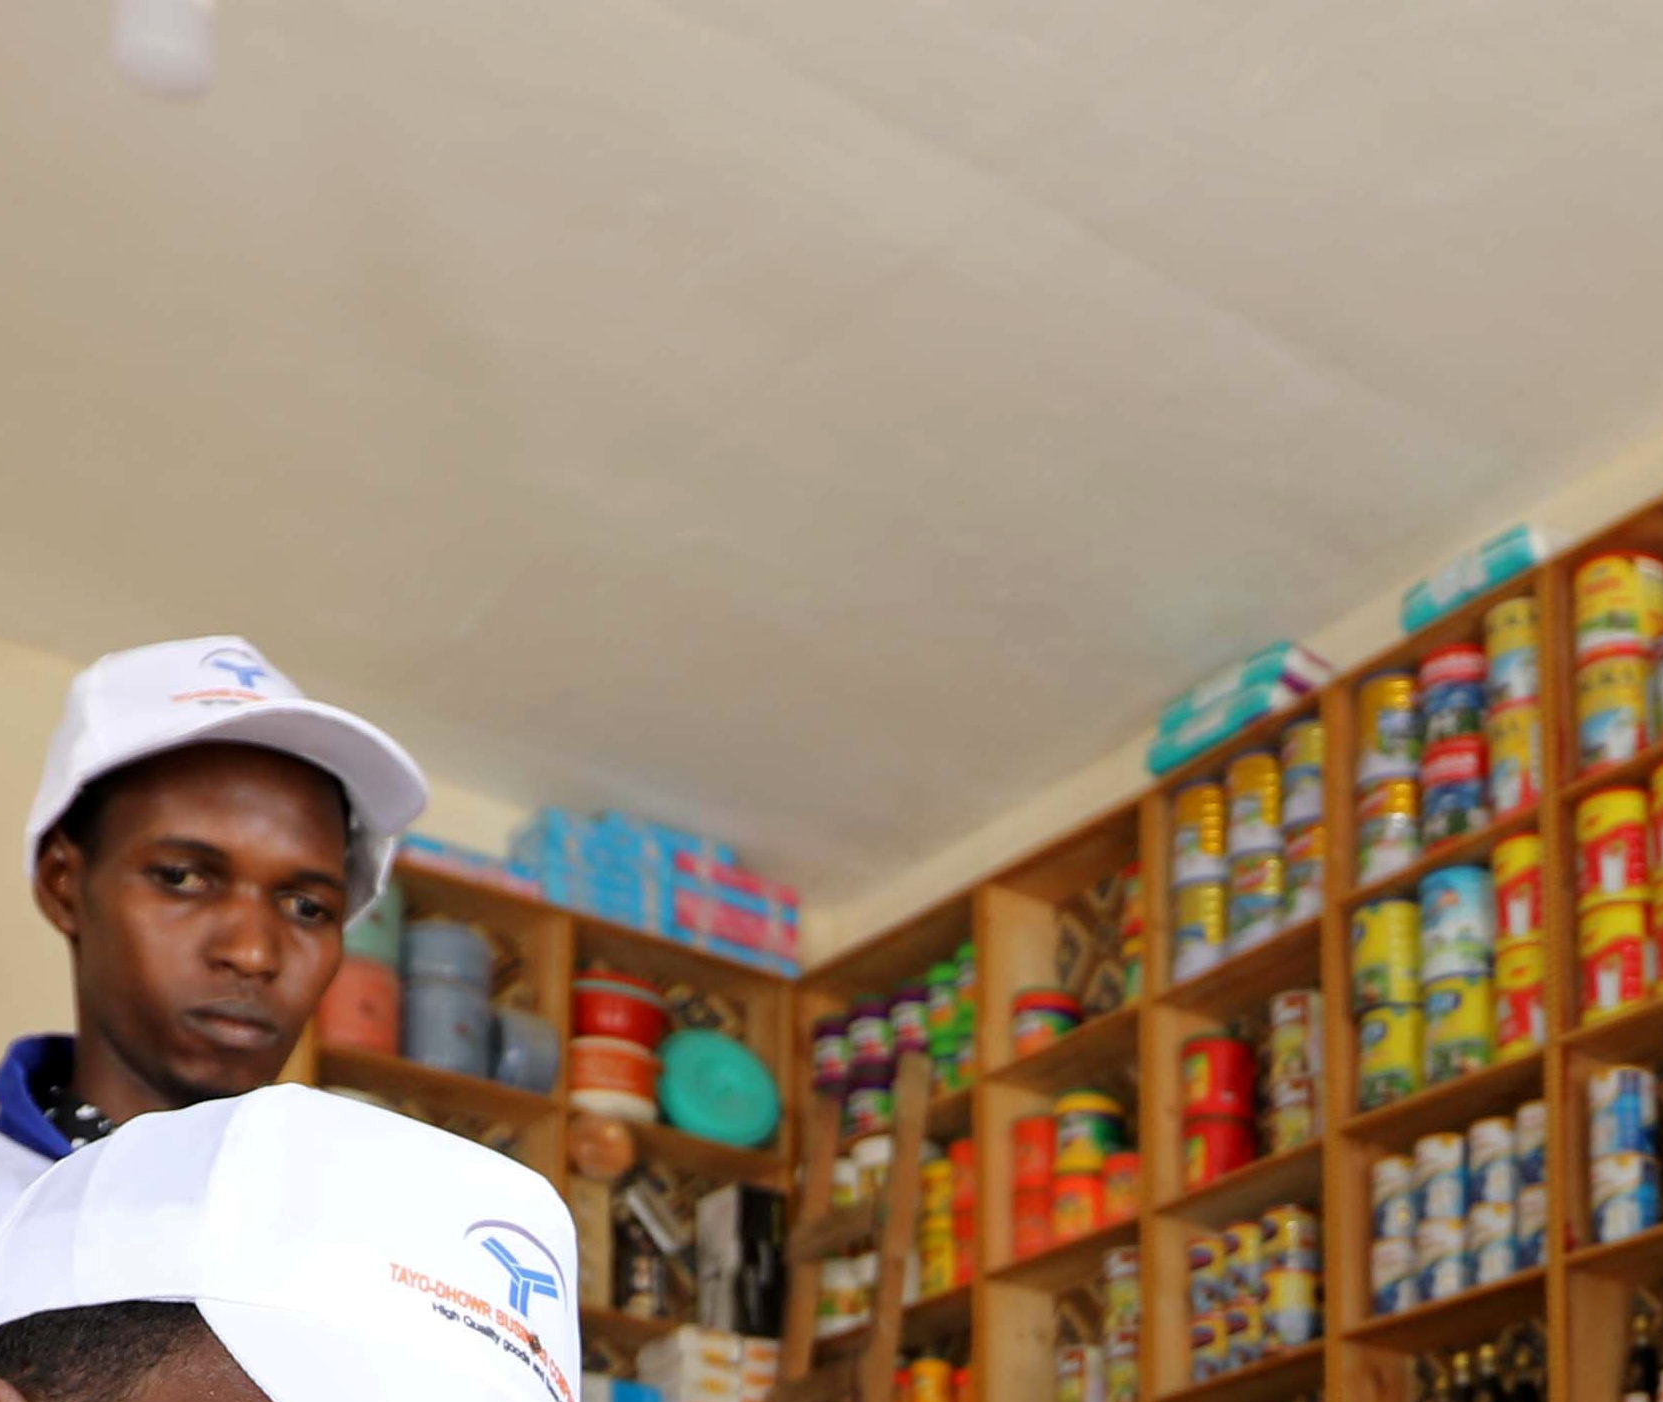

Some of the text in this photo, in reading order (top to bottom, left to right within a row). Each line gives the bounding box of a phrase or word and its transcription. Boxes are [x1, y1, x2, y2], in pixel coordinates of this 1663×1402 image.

[389, 1262, 493, 1319] TAYO-DHOWR
[432, 1302, 460, 1322] High
[463, 1315, 500, 1344] Quality
[503, 1339, 530, 1365] goods
